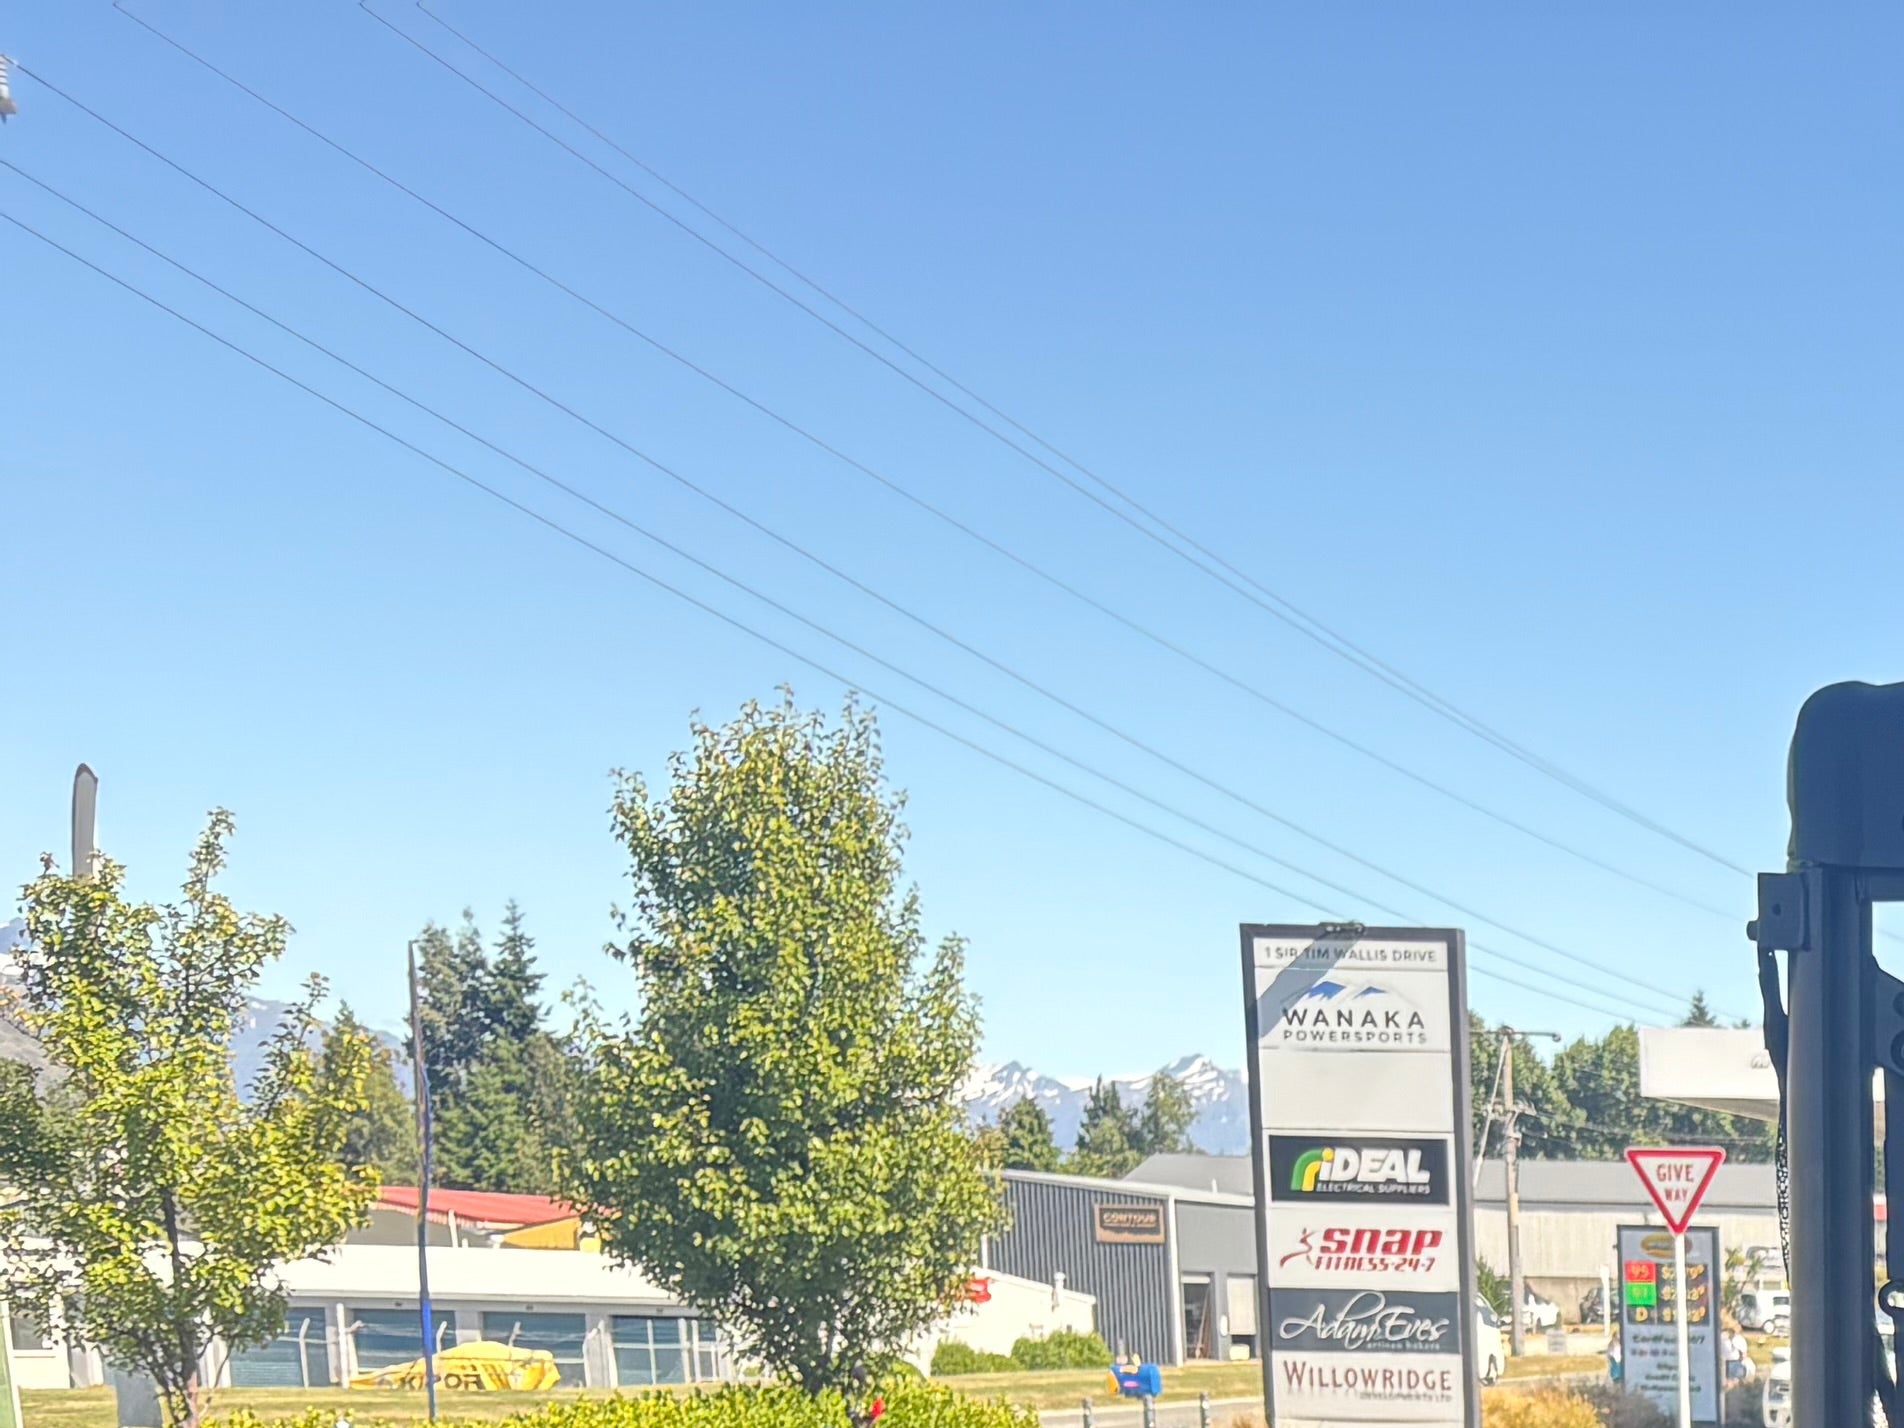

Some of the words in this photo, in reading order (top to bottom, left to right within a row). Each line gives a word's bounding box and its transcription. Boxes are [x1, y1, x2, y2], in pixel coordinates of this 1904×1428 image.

[1275, 946, 1298, 960] SIR
[1305, 947, 1329, 960] TIM
[1333, 948, 1388, 962] WALLIS
[1392, 949, 1437, 963] DRIVE
[1281, 1007, 1426, 1030] WANAKA
[1283, 1030, 1428, 1045] POWERSPORTS
[1656, 1163, 1695, 1184] GIVE
[1316, 1182, 1376, 1194] ELECTRICAL
[1378, 1183, 1431, 1195] SUPPLIERS
[1664, 1187, 1690, 1203] WAY
[1279, 1291, 1385, 1350] Adam
